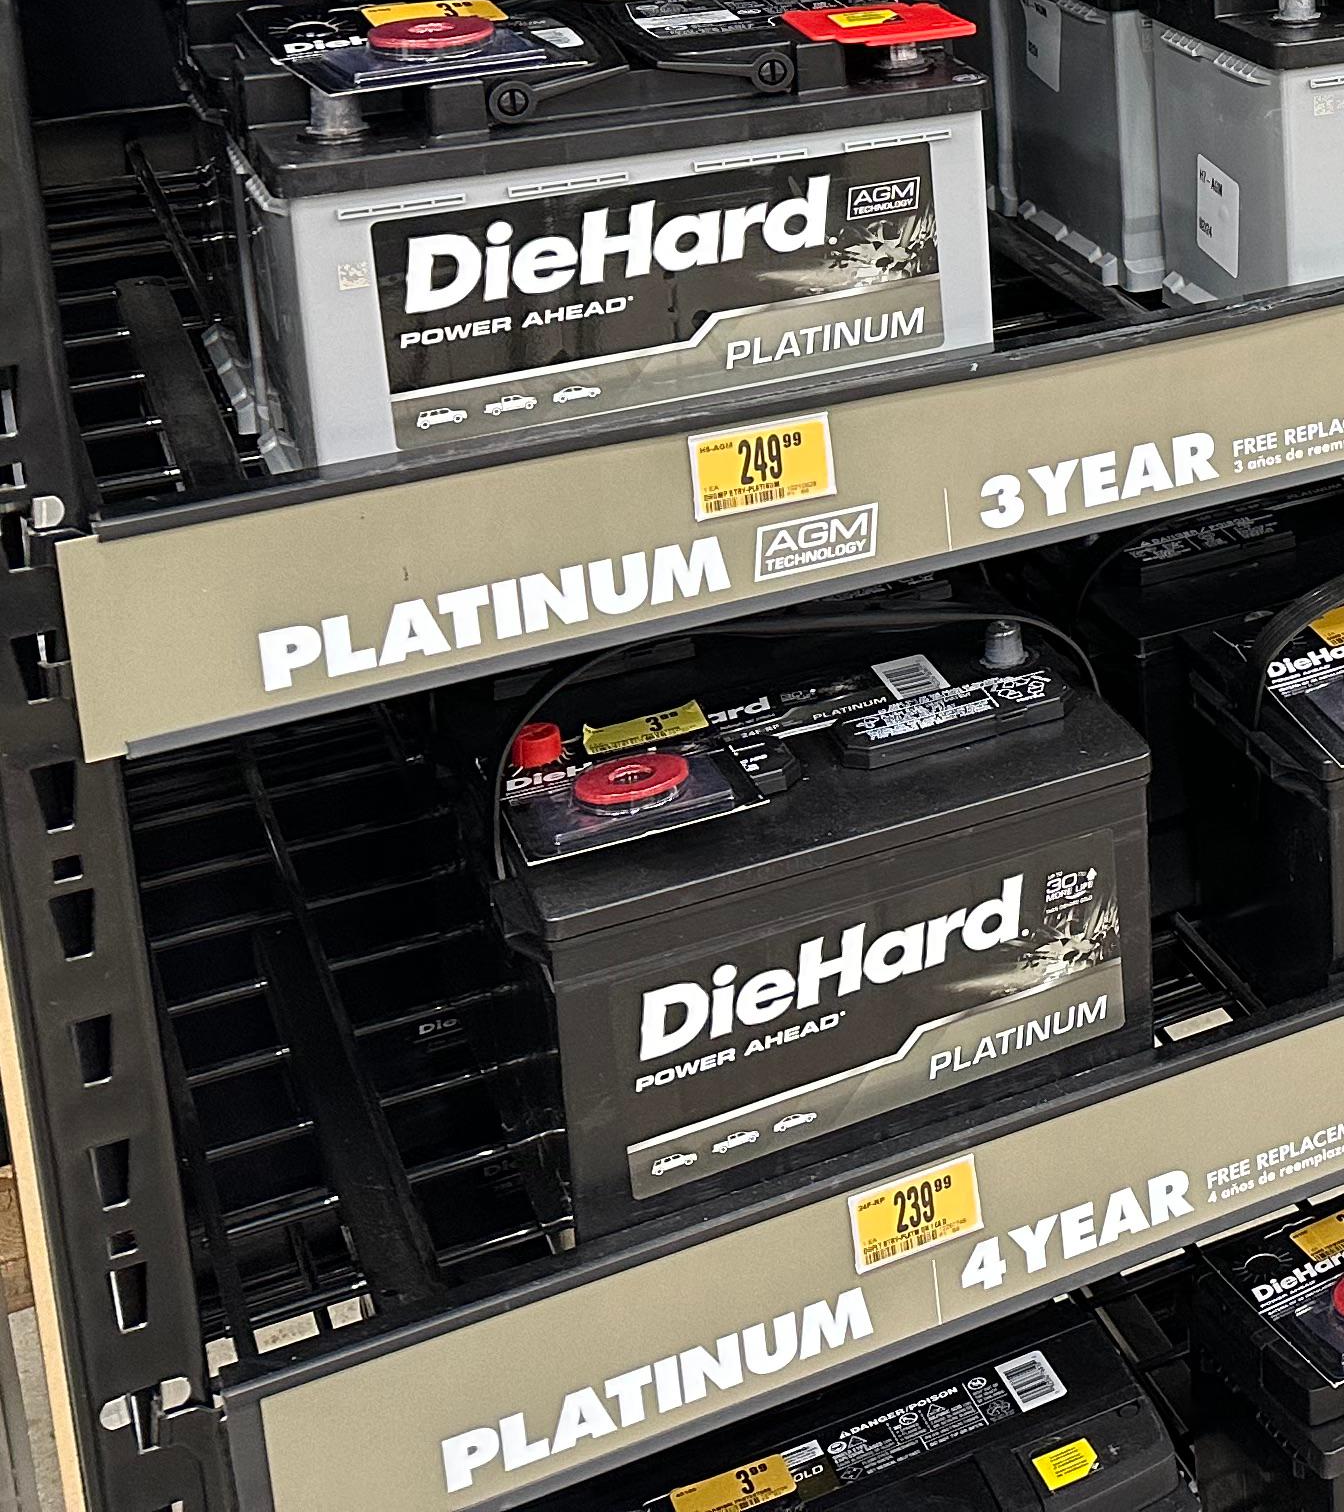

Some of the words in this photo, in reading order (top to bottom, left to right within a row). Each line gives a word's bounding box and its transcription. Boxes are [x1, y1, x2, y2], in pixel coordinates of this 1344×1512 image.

[851, 181, 917, 207] AGM
[853, 195, 916, 217] TECHNOLOGY
[405, 174, 831, 314] DieHard
[400, 318, 511, 349] POWER
[522, 297, 627, 330] AHEAD
[726, 307, 926, 371] PLATINUM
[980, 474, 1025, 530] 3
[1027, 432, 1216, 519] YEAR
[765, 512, 869, 557] AGM
[765, 539, 866, 572] TECHNOLOGY
[258, 535, 731, 691] PLATINUM
[639, 874, 1026, 1061] DieHard
[636, 1048, 737, 1093] POWER
[744, 1014, 839, 1055] AHEAD
[929, 995, 1108, 1080] PLATINUM
[1206, 1163, 1252, 1189] FREE
[1208, 1189, 1216, 1203] 4
[1221, 1180, 1251, 1202] años
[1256, 1173, 1274, 1191] de
[961, 1237, 1007, 1289] 4
[1008, 1170, 1194, 1273] YEAR
[442, 1286, 875, 1493] PLATINUM
